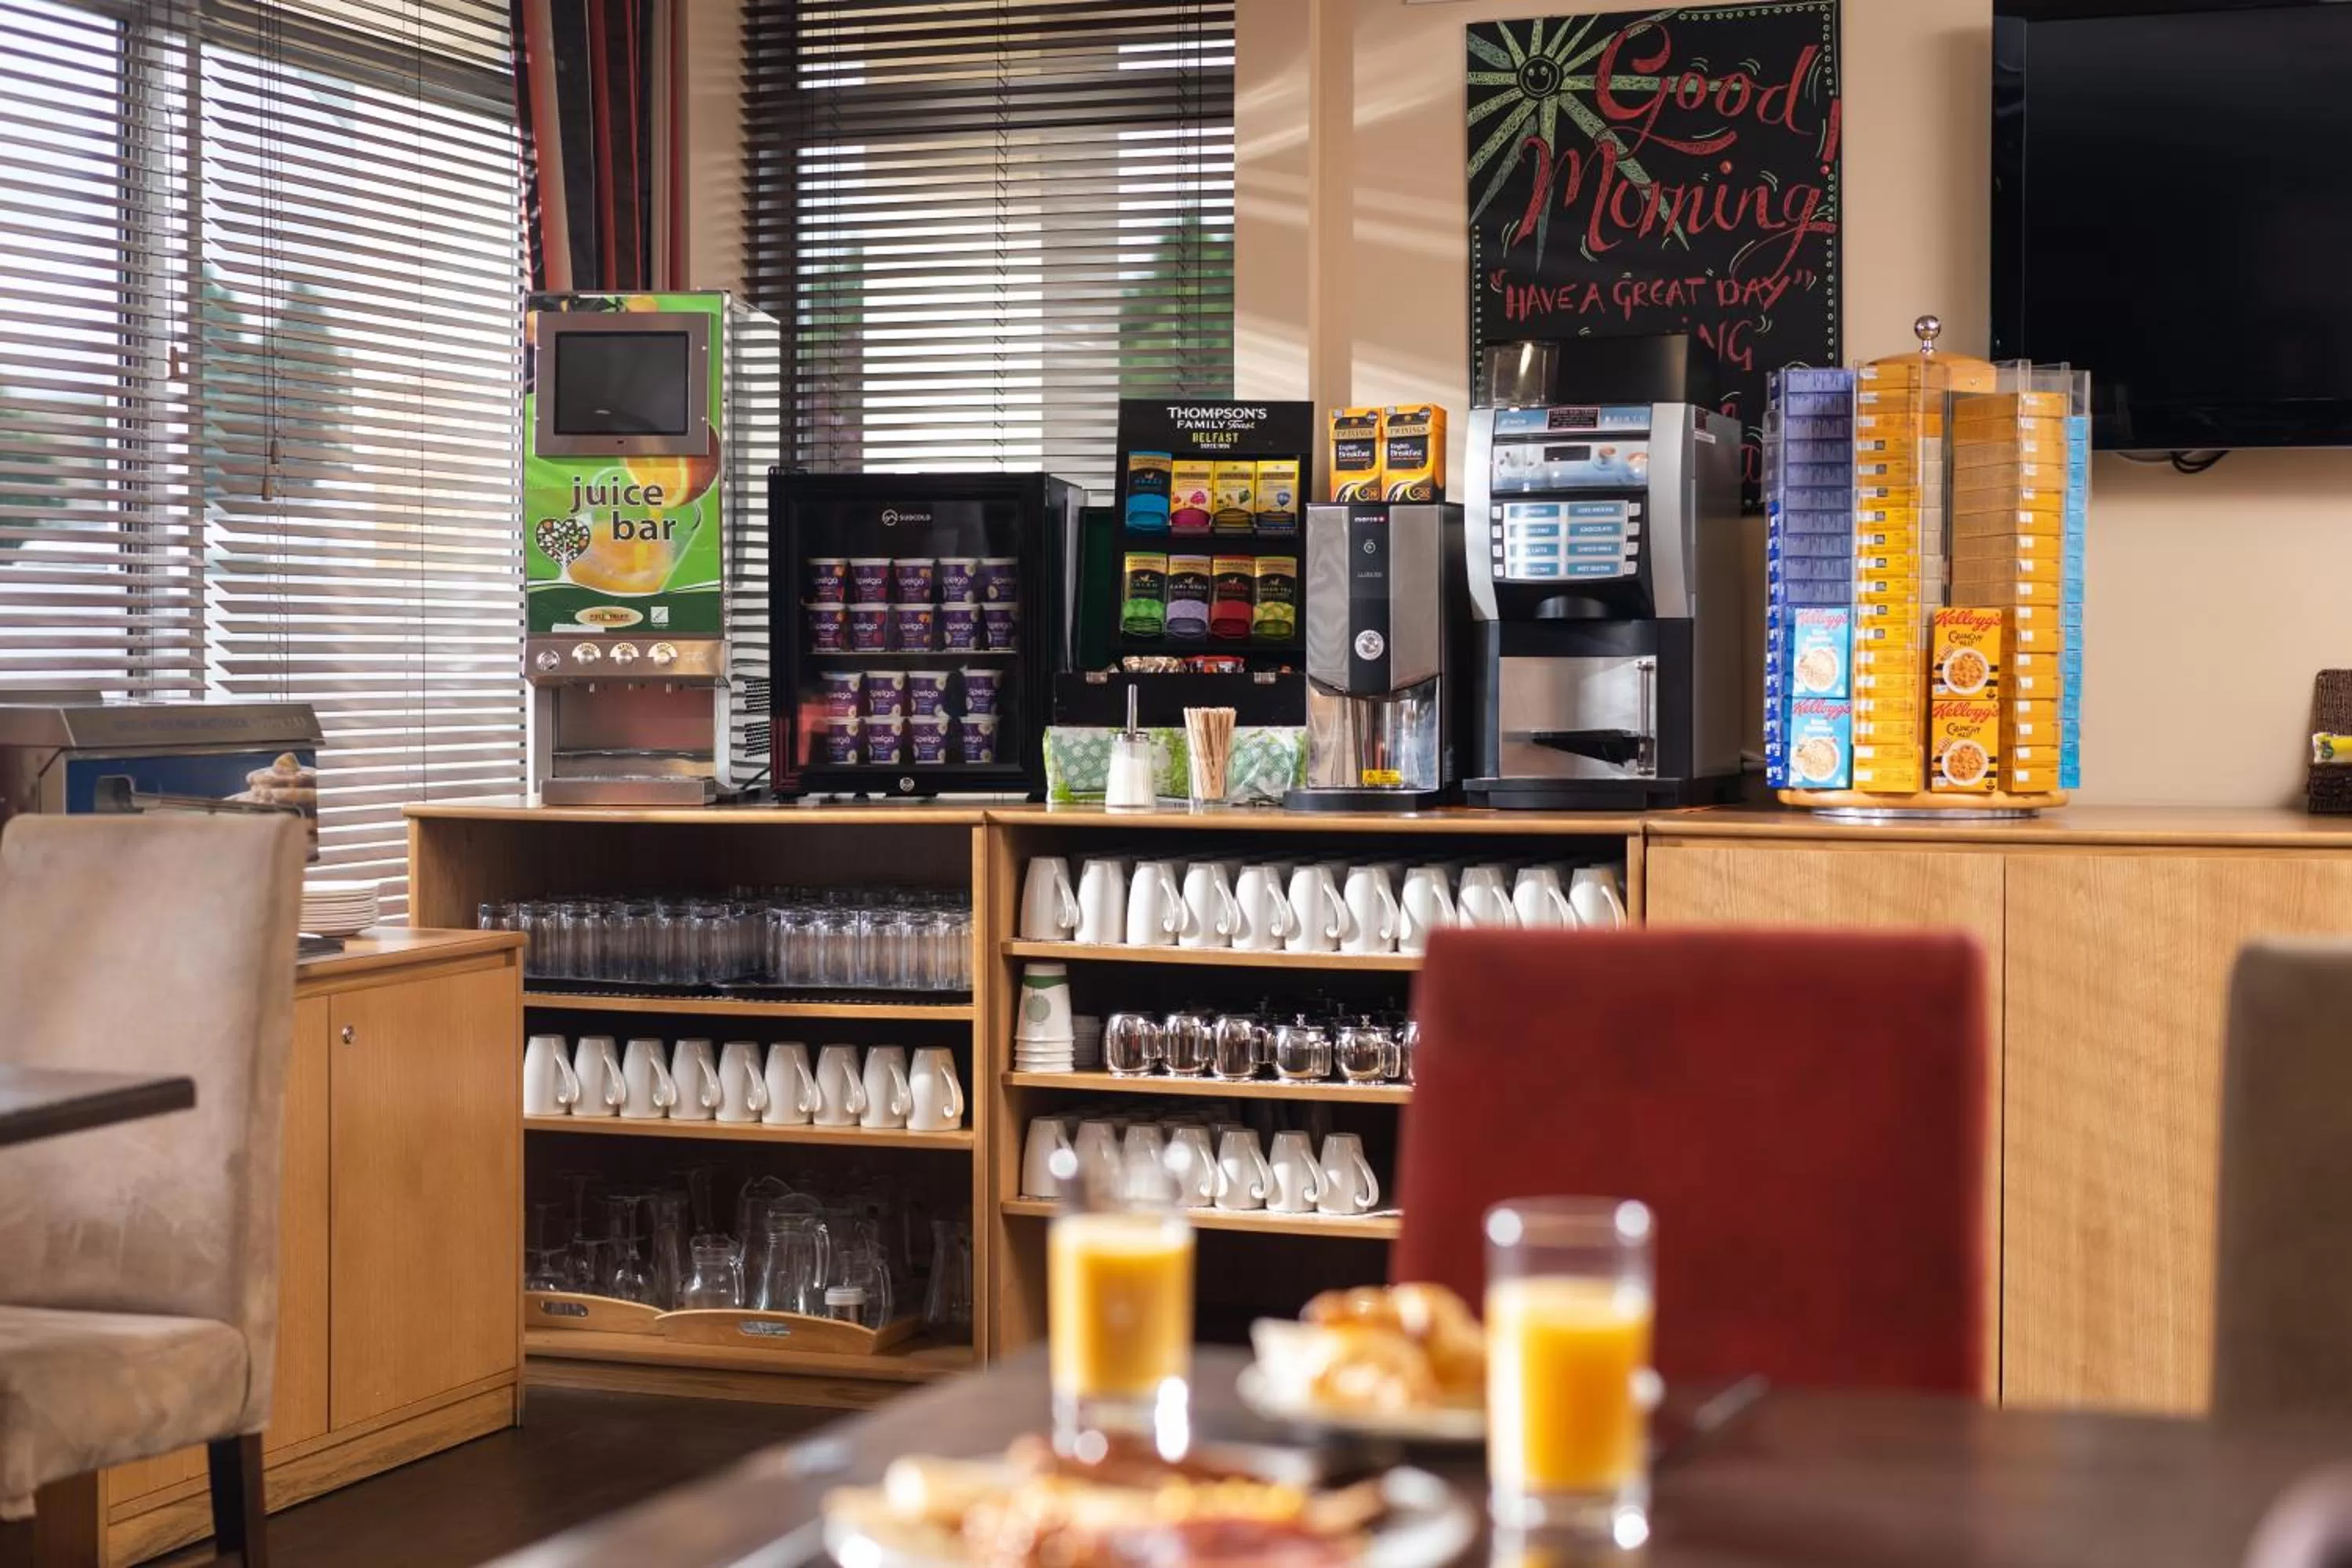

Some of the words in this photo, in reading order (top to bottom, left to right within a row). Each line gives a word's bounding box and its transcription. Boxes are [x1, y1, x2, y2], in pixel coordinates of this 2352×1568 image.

[1594, 21, 1817, 154] Good
[1579, 282, 1606, 314] A
[1612, 277, 1708, 321] GREAT
[1167, 406, 1267, 419] THOMPSON'S
[1177, 419, 1225, 429] FAMILY
[1192, 432, 1240, 443] BELFAST
[570, 476, 664, 514] juice
[612, 511, 676, 541] bar
[1935, 608, 2002, 632] Kellogg's
[1932, 702, 2000, 723] Kellogg's
